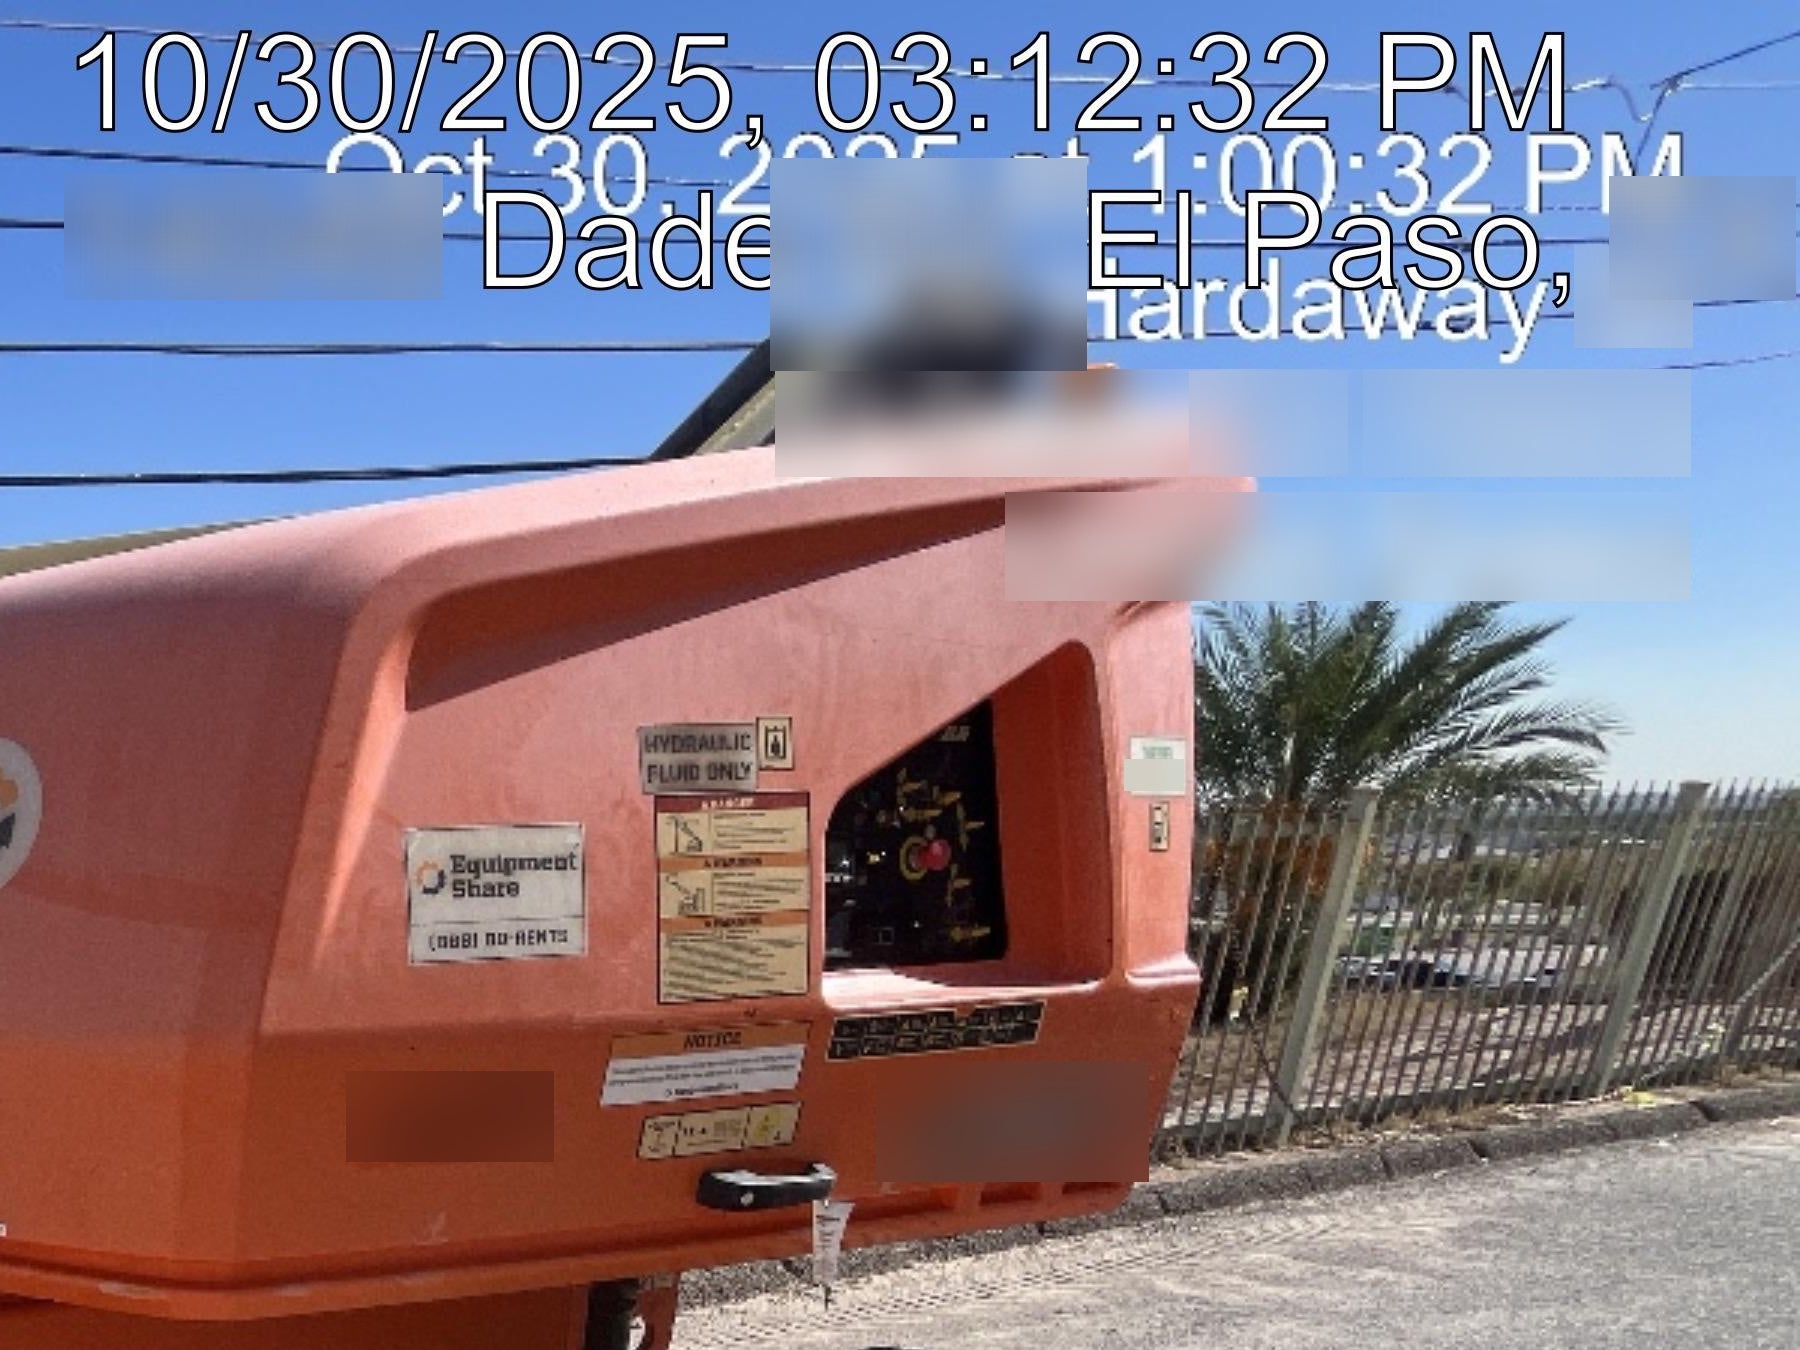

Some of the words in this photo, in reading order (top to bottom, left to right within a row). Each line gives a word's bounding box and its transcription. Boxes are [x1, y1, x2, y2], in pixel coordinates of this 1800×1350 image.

[645, 732, 751, 753] HYDRAULIC
[647, 764, 700, 783] FLUID
[708, 761, 752, 780] ONLY
[450, 851, 577, 878] Equipment
[452, 879, 520, 898] Share
[683, 1032, 742, 1049] NOTICE
